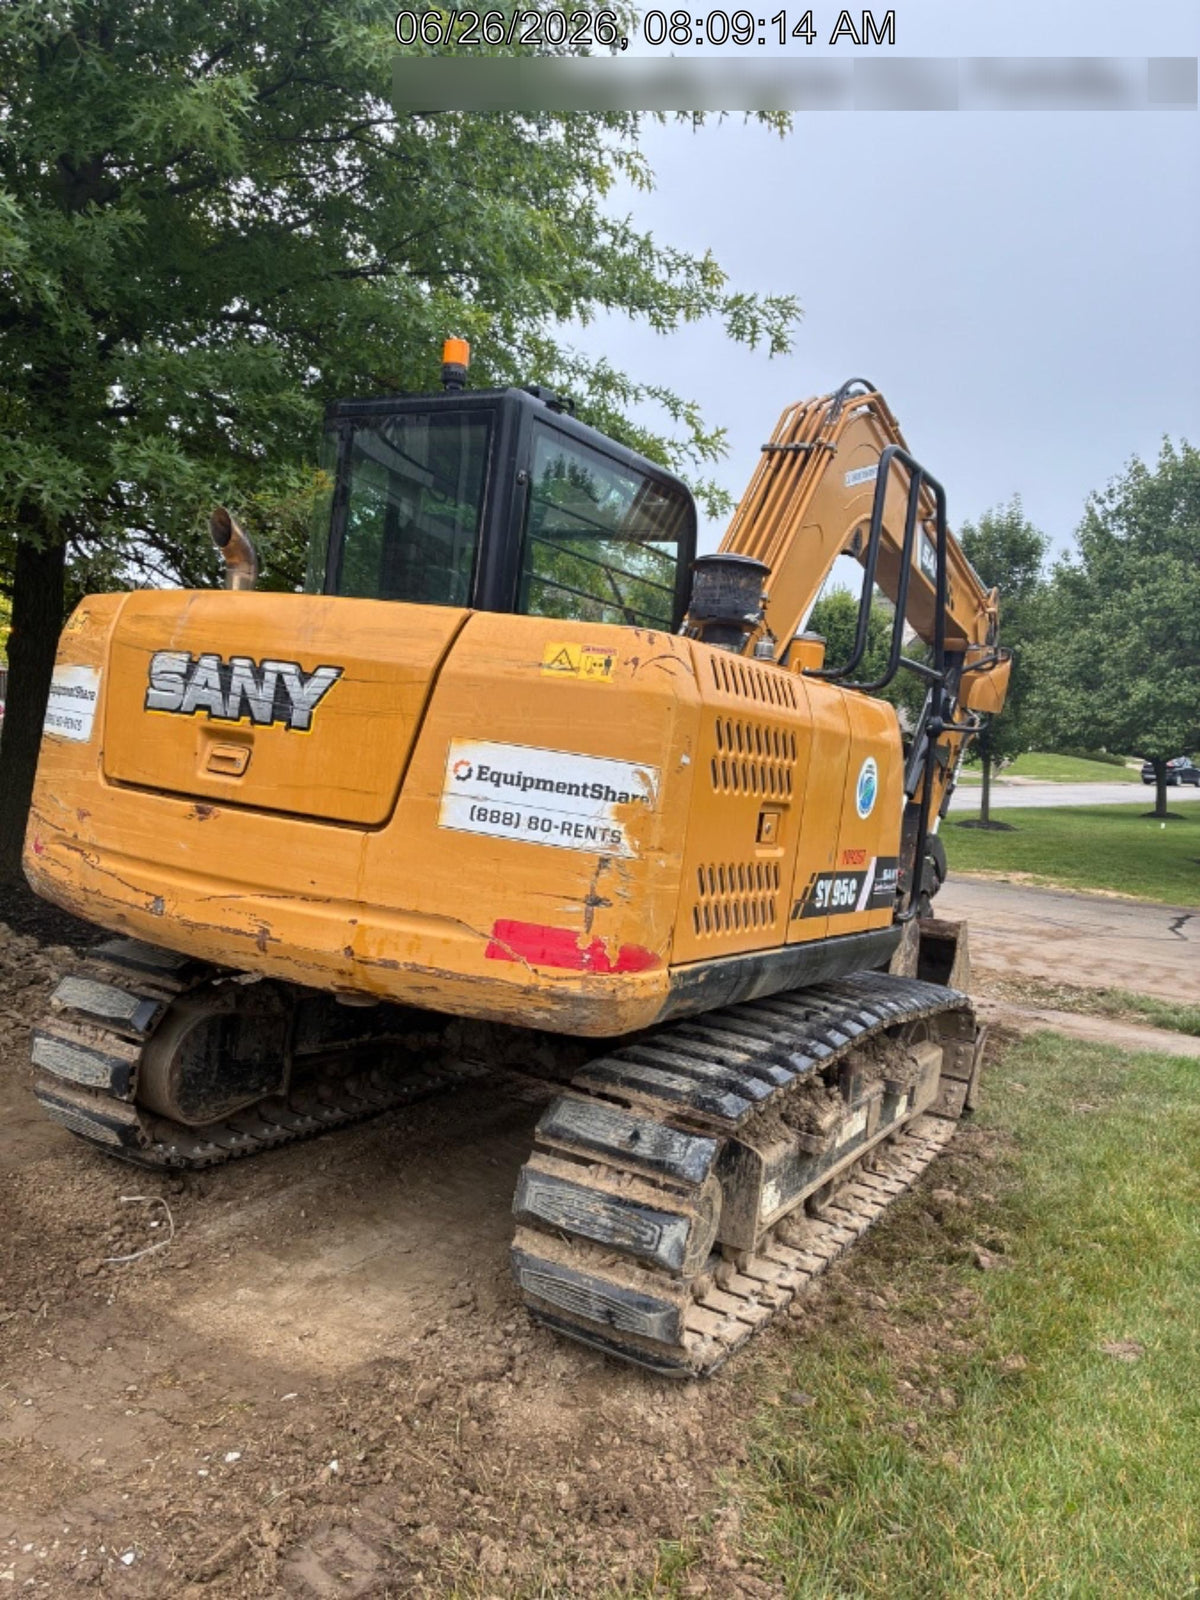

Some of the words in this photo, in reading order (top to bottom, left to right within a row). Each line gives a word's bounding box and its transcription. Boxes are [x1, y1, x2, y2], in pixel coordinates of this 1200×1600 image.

[144, 650, 345, 732] SANY
[476, 764, 650, 805] EquipmentShare
[469, 805, 522, 830] (888)
[527, 815, 623, 844] 80-RENTS
